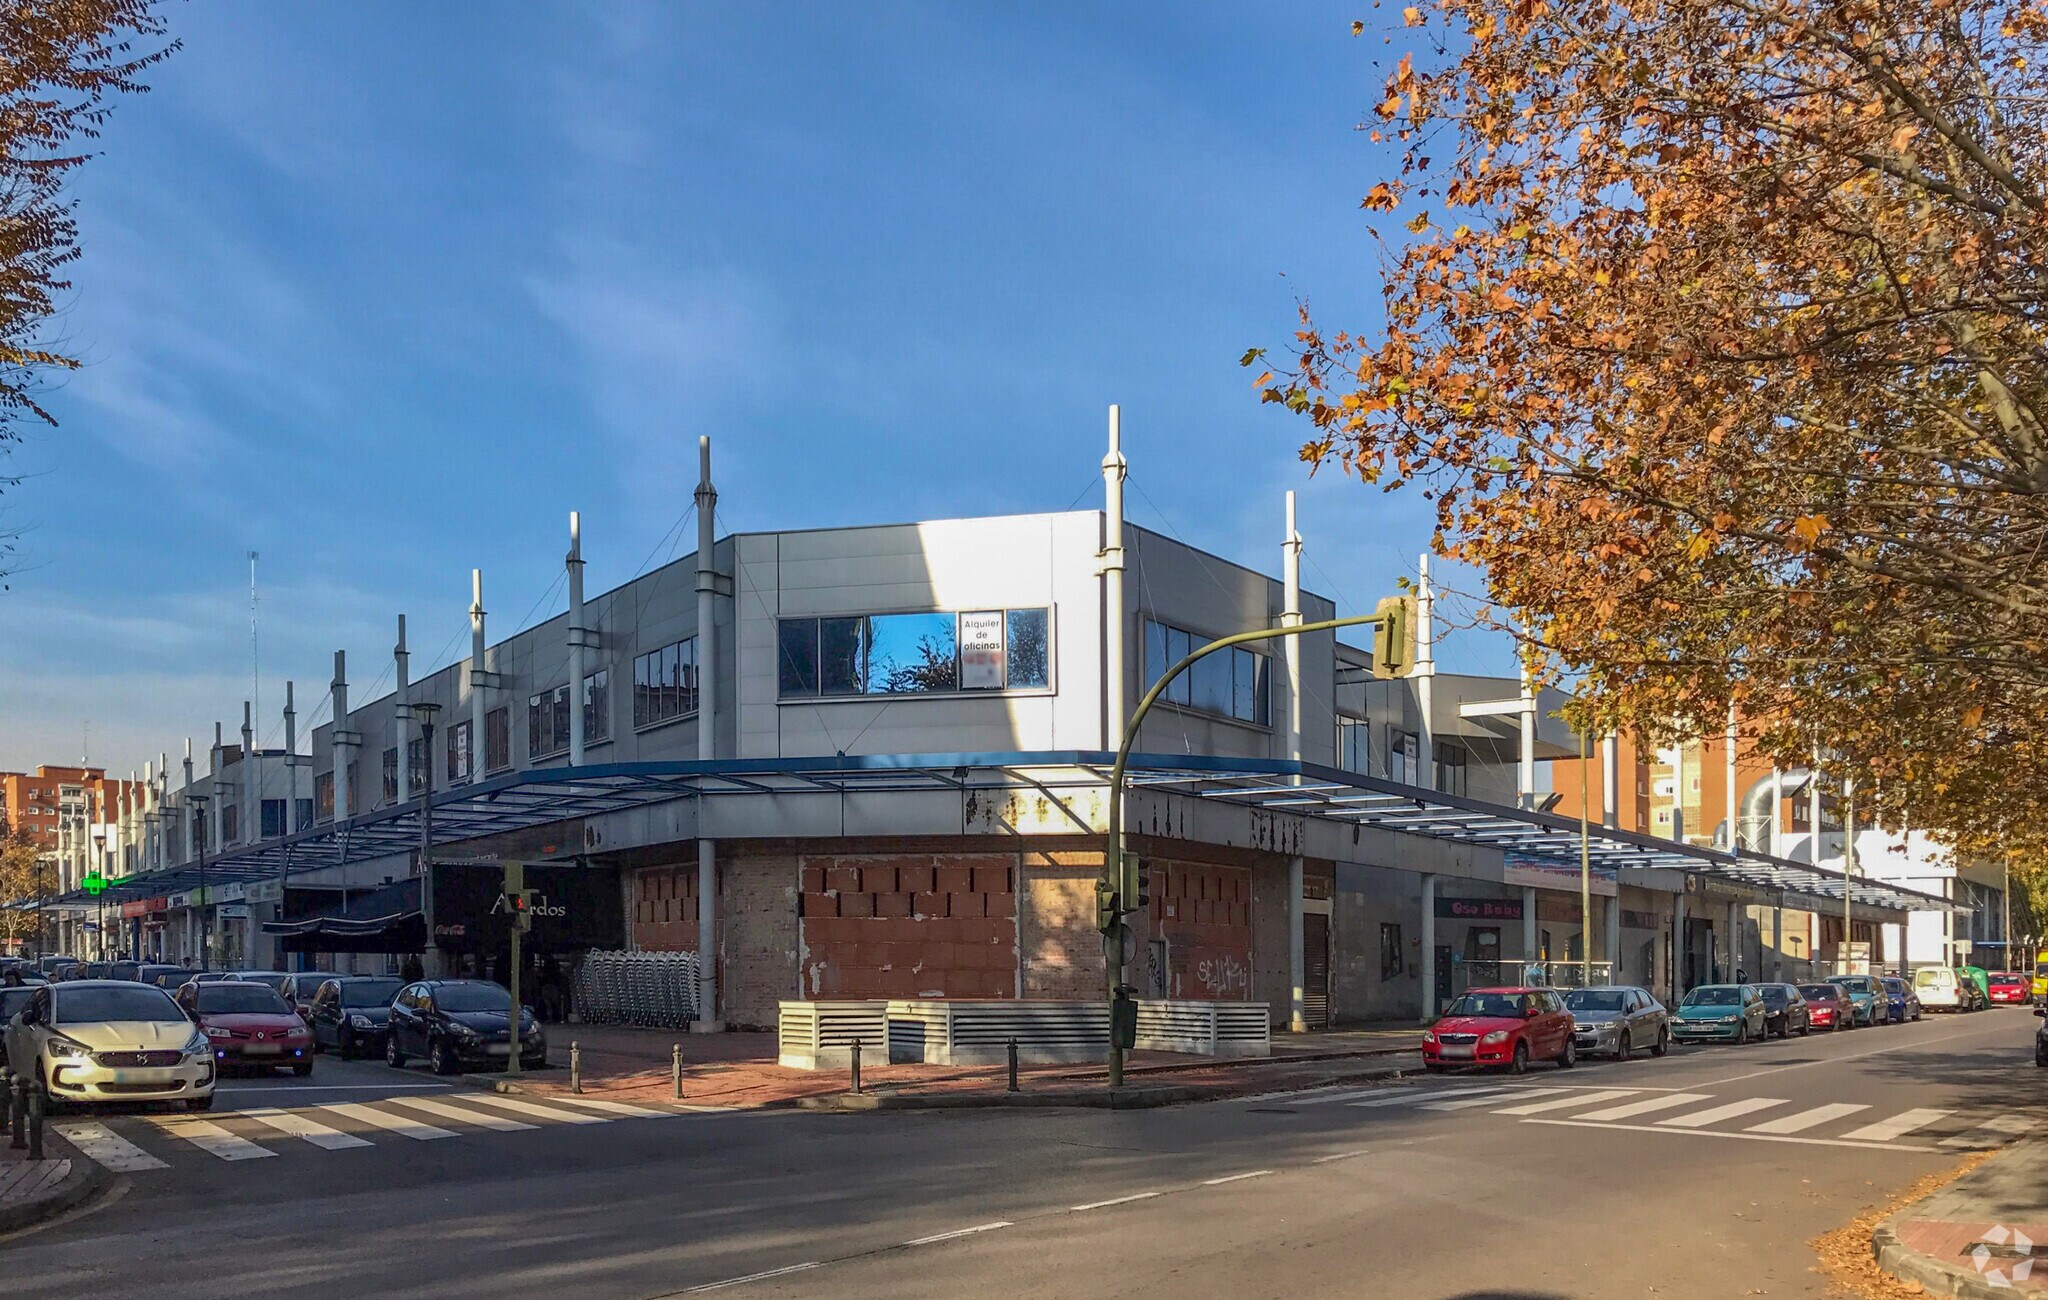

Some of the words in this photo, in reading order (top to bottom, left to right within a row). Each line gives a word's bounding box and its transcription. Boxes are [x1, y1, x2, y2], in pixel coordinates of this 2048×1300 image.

[965, 620, 999, 629] Alquiler
[976, 631, 988, 639] de
[964, 642, 1000, 651] oficinas
[1452, 902, 1478, 915] Oso
